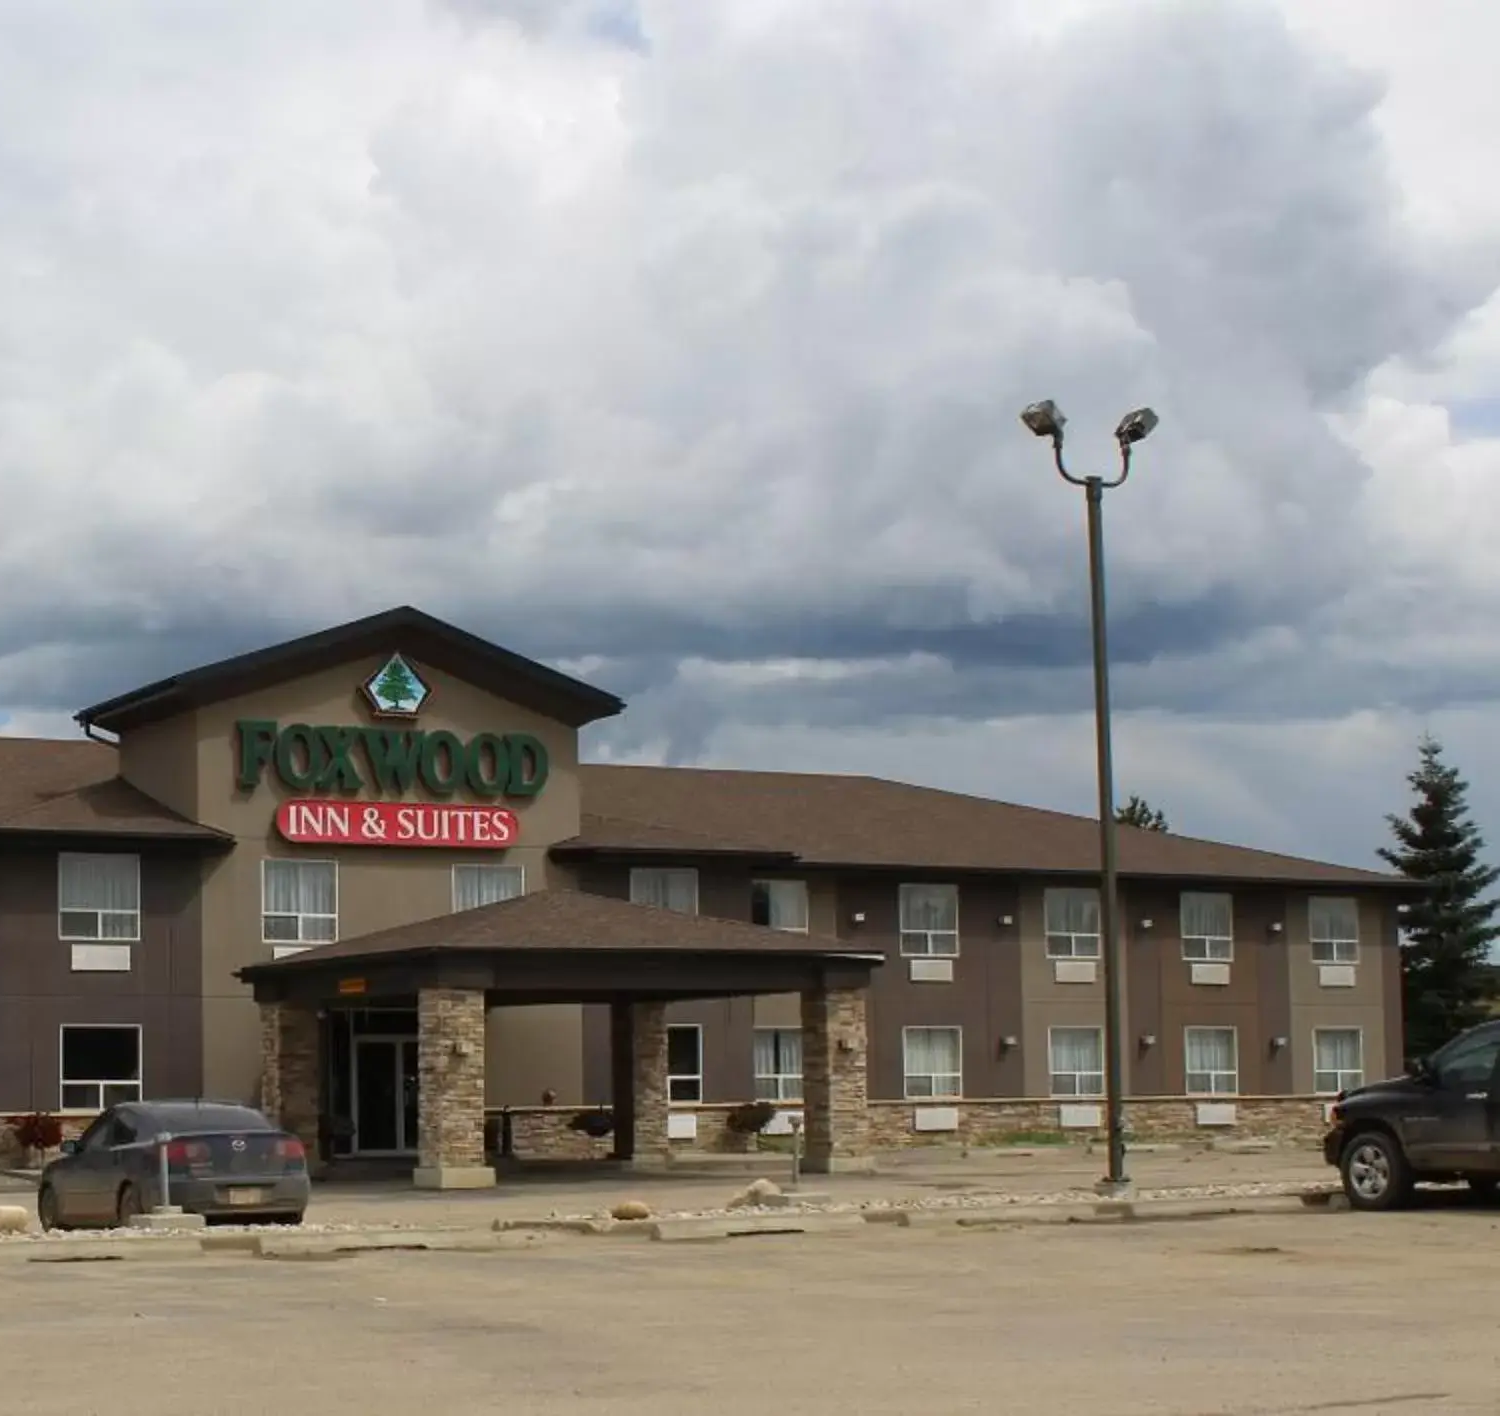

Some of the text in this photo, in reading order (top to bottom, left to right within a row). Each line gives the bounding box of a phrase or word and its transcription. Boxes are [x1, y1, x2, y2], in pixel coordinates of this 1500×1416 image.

[237, 719, 549, 797] FOXWOOD
[288, 805, 509, 841] INN & SUITES
